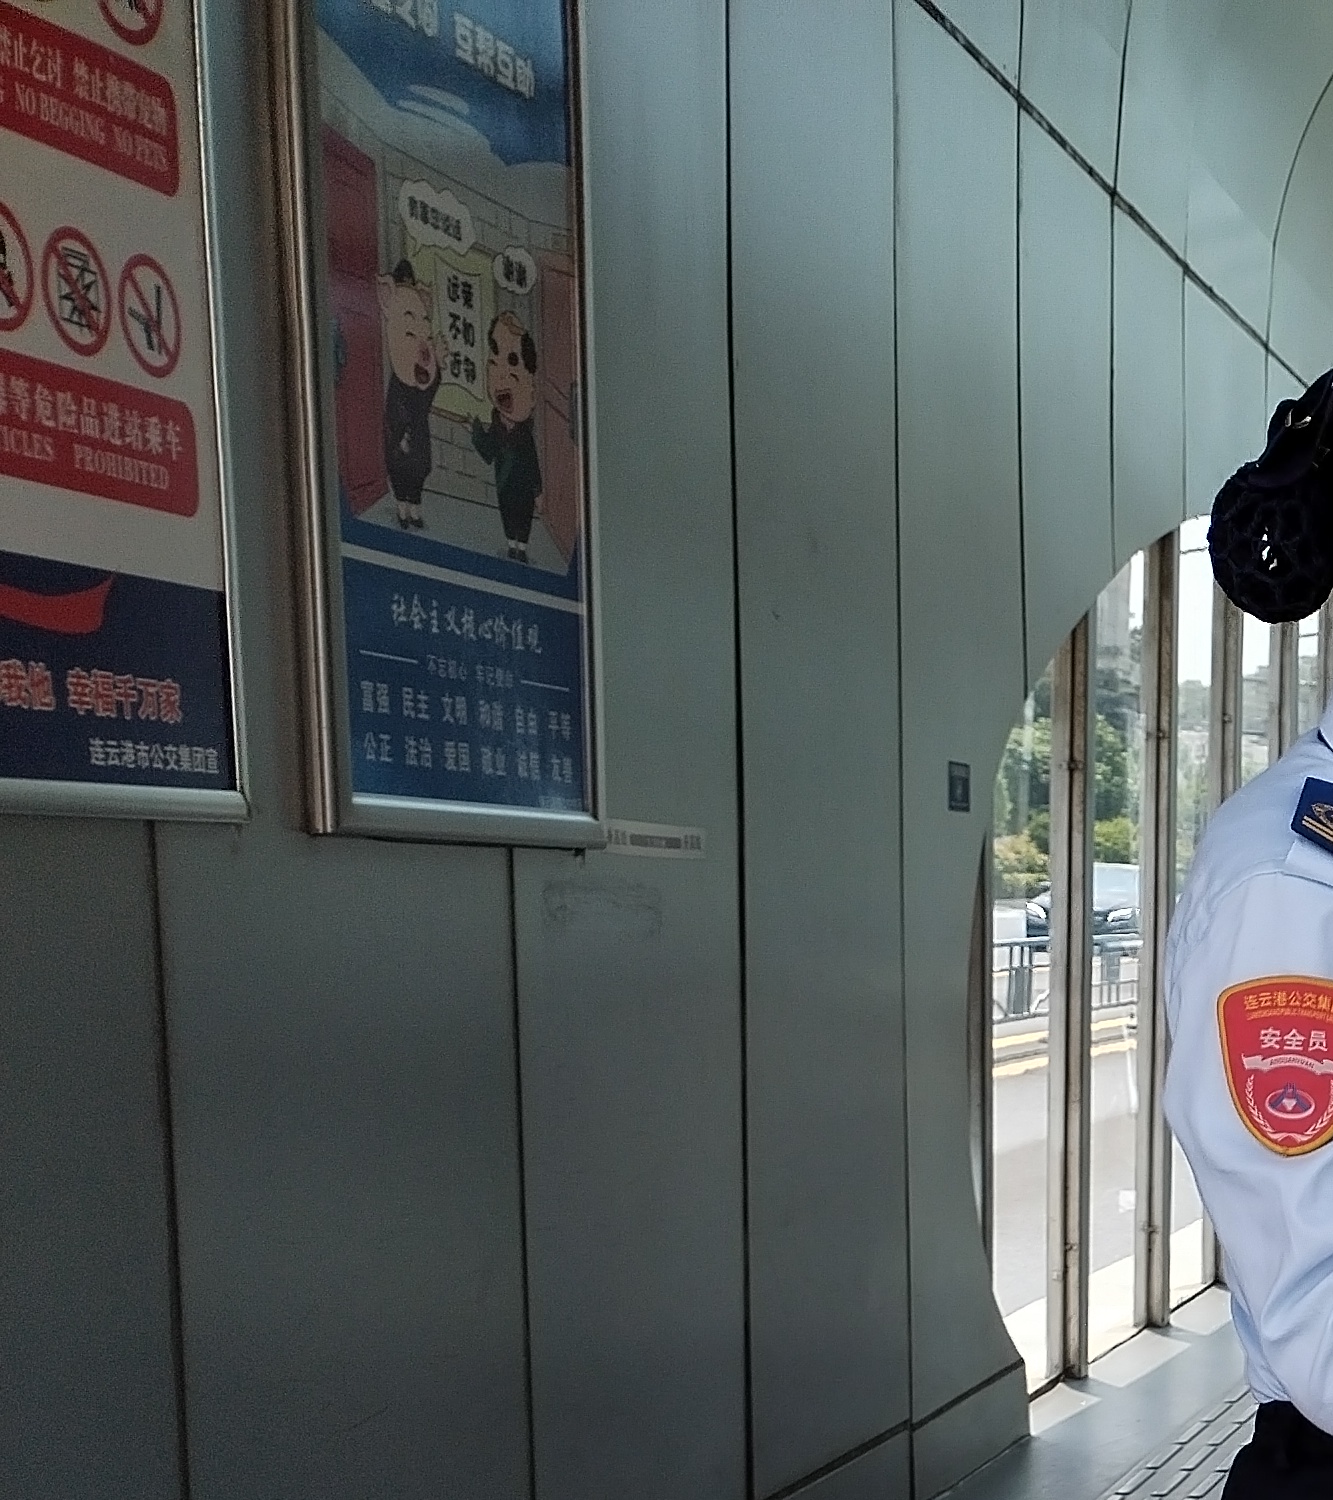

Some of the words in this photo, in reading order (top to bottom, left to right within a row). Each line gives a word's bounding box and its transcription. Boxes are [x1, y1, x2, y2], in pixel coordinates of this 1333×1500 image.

[391, 593, 542, 654] 社会主义核心价值观
[67, 667, 183, 724] 幸福千万家
[361, 680, 390, 715] 富强
[402, 687, 430, 721] 民主
[441, 693, 468, 726] 文明
[515, 704, 538, 736] 自由
[549, 710, 571, 741] 平等
[88, 737, 220, 774] 连云港市公交集团宣
[364, 731, 393, 763] 公正
[404, 735, 433, 769] 法治
[444, 740, 471, 773] 爱国
[1260, 1026, 1328, 1052] 安全员
